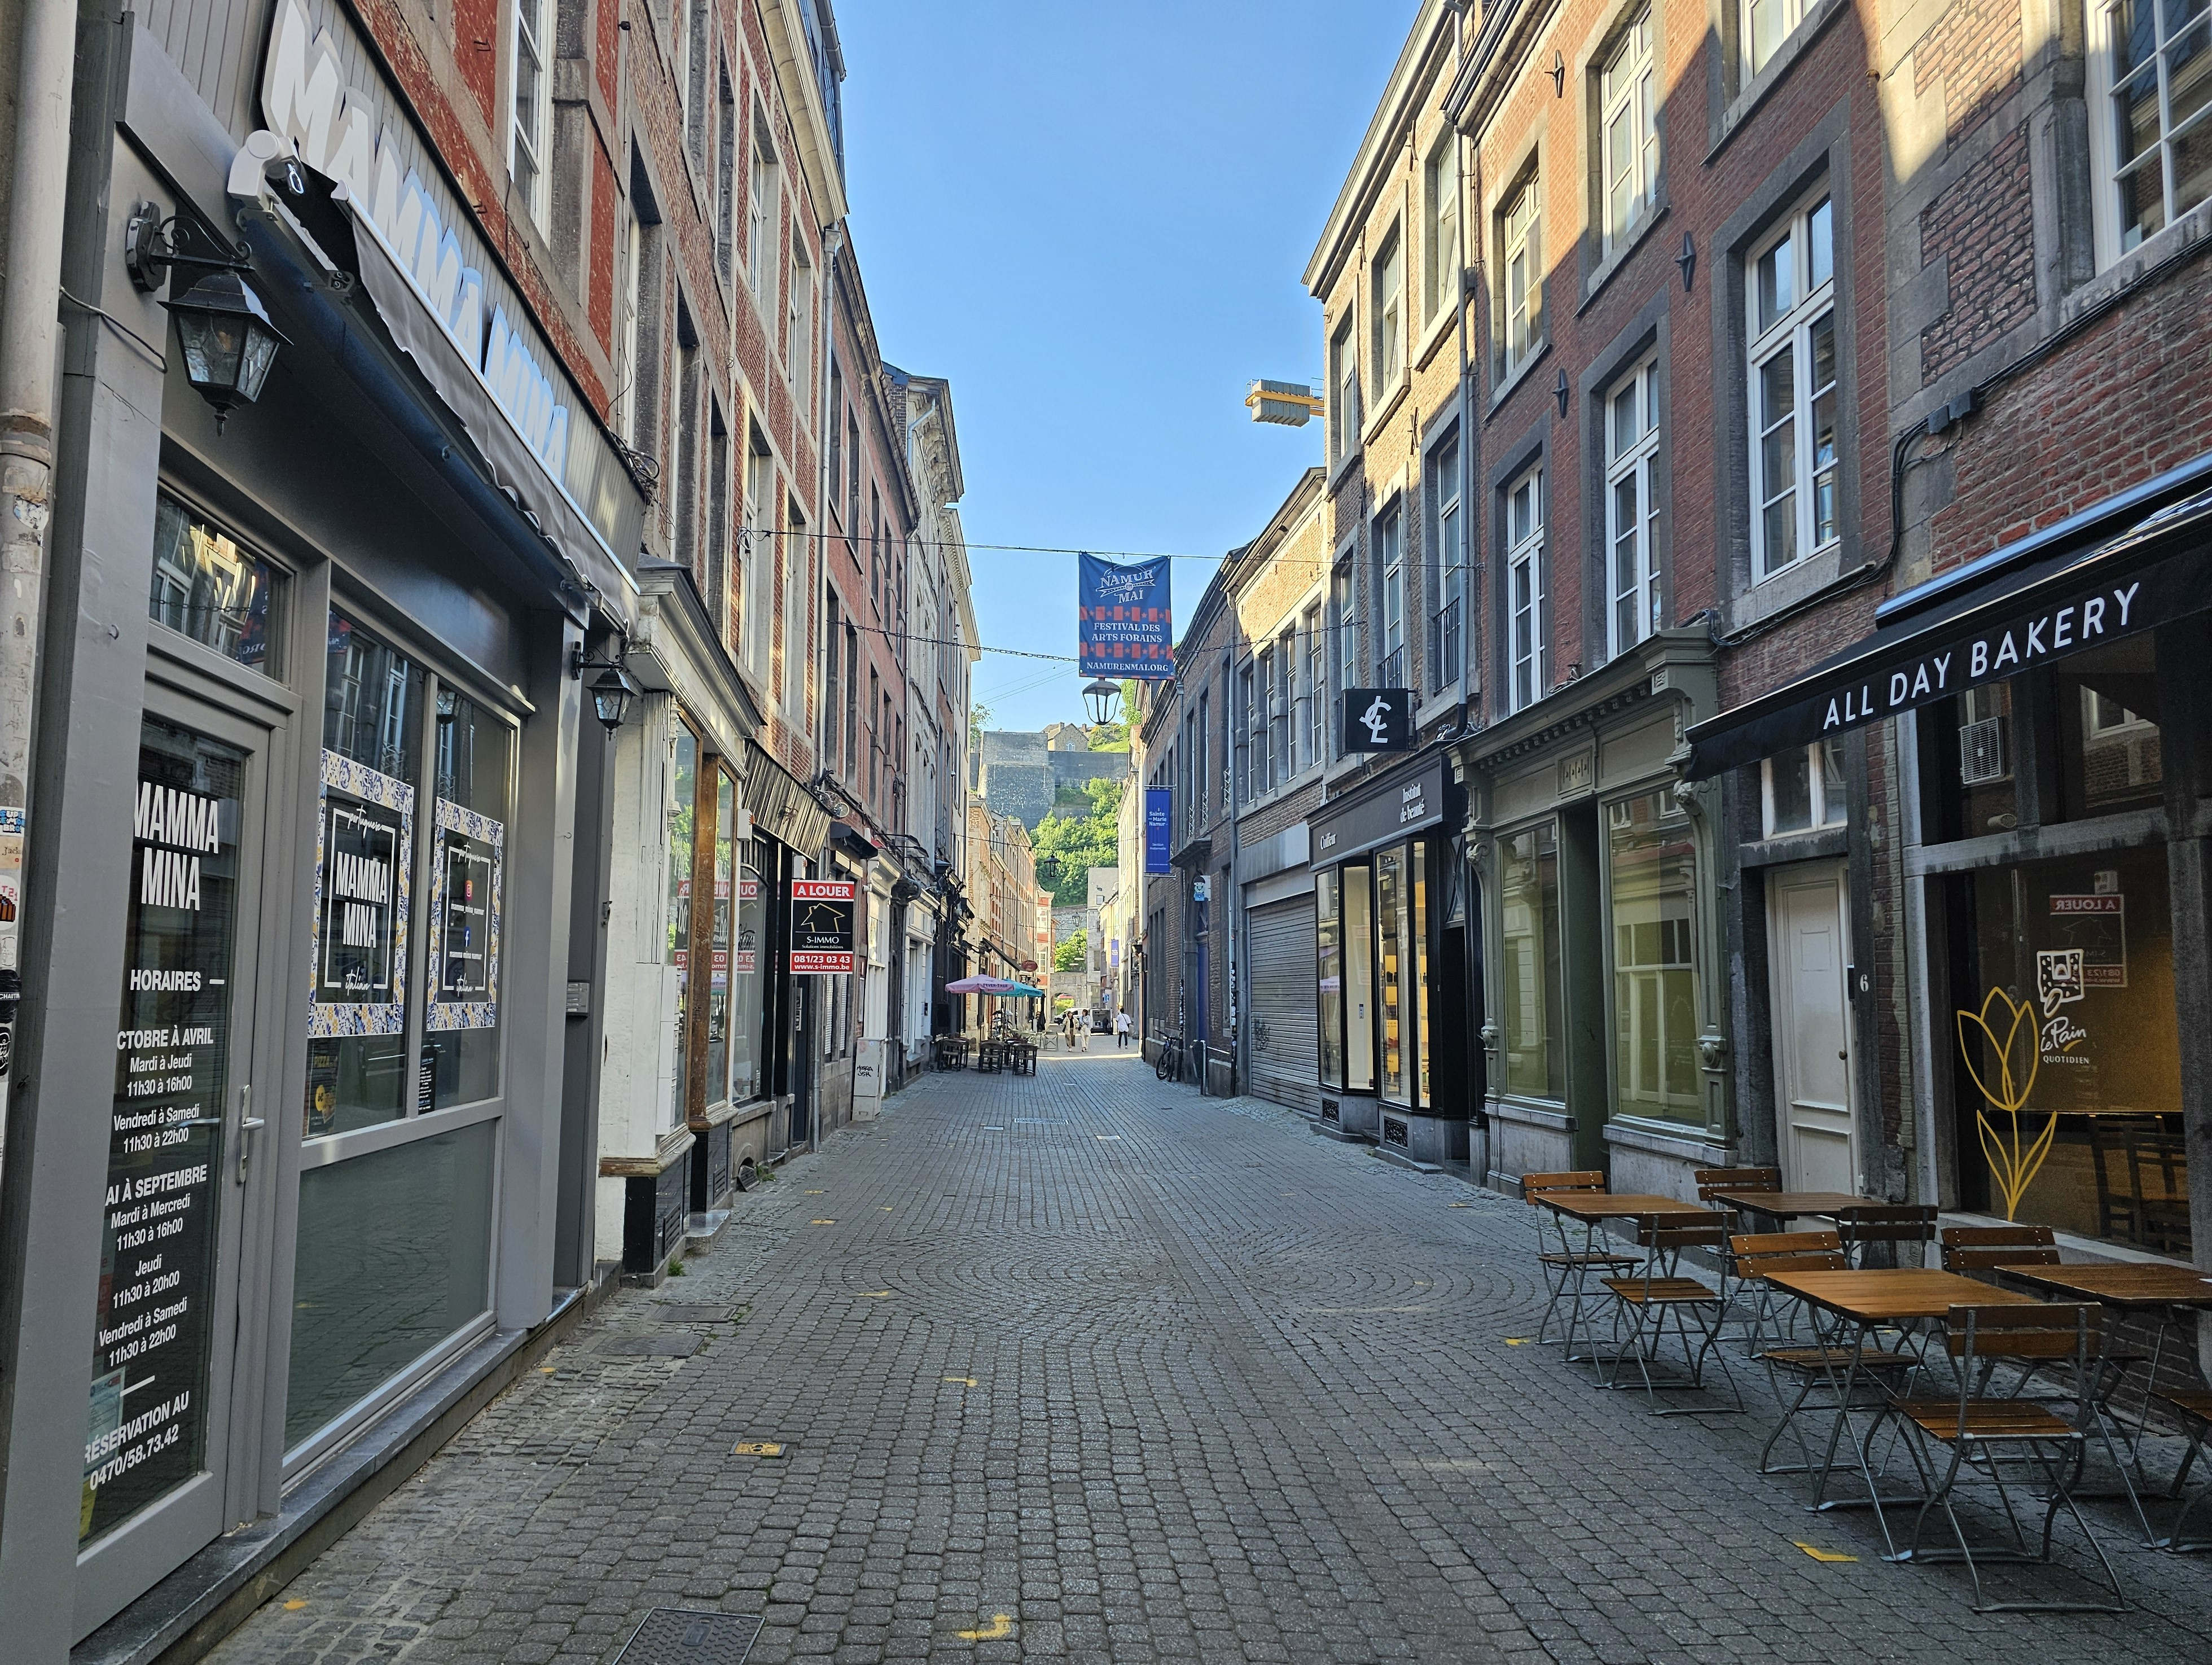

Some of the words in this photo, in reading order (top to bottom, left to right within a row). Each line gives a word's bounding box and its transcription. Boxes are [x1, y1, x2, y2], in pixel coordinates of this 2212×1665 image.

[263, 0, 482, 373] MAMMA
[484, 304, 567, 484] MINA
[1098, 567, 1155, 589] NAMUR
[1114, 588, 1143, 603] MAI
[1094, 623, 1140, 632] FESTIVAL
[1142, 623, 1160, 632] DES
[1120, 634, 1162, 642] FORAINS
[1086, 662, 1168, 672] NAMURENMAI.ORG
[1823, 685, 1874, 730] ALL
[1889, 652, 1951, 706] DAY
[1970, 582, 2139, 677] BAKERY
[134, 782, 218, 853] MAMMA
[1400, 807, 1407, 823] de
[1407, 798, 1424, 820] beauté
[142, 847, 200, 910] MINA
[336, 851, 388, 904] MAMMA
[797, 885, 806, 896] A
[809, 885, 850, 897] LOUER
[343, 902, 377, 948] MINA
[794, 955, 823, 963] 081/23
[130, 969, 201, 991] HORAIRES
[1860, 974, 1869, 992] 6
[117, 1029, 169, 1050] CTOBRE
[170, 1024, 179, 1046] À
[182, 1027, 213, 1046] AVRIL
[2042, 1016, 2086, 1048] Pain
[130, 1054, 157, 1073] Mardi
[159, 1055, 165, 1070] à
[168, 1053, 192, 1070] Jeudi
[2043, 1055, 2090, 1064] QUOTIDIEN
[127, 1079, 155, 1097] 11h30
[158, 1078, 163, 1093] à
[166, 1075, 192, 1093] 16h00
[114, 1109, 157, 1131] Vendredi
[159, 1107, 164, 1123] à
[166, 1103, 199, 1123] Samedi
[124, 1133, 152, 1154] 11h30
[154, 1132, 160, 1147] à
[162, 1127, 189, 1146] 22h00
[105, 1185, 119, 1206] AI
[122, 1178, 131, 1202] À
[135, 1164, 207, 1199] SEPTEMBRE
[111, 1207, 139, 1229] Mardi
[142, 1204, 148, 1220] à
[150, 1193, 191, 1217] Mercredi
[117, 1228, 146, 1251] 11h30
[148, 1226, 154, 1242] à
[157, 1217, 183, 1239] 16h00
[135, 1254, 162, 1277] Jeudi
[113, 1286, 142, 1309] 11h30
[144, 1281, 150, 1297] à
[152, 1270, 179, 1294] 20h00
[99, 1315, 143, 1347] Vendredi
[145, 1312, 151, 1328] à
[153, 1296, 187, 1324] Samedi
[109, 1340, 139, 1366] 11h30
[141, 1337, 147, 1353] à
[148, 1324, 176, 1349] 22h00
[172, 1391, 189, 1415] AU
[90, 1423, 178, 1491] 0470/58.73.42
